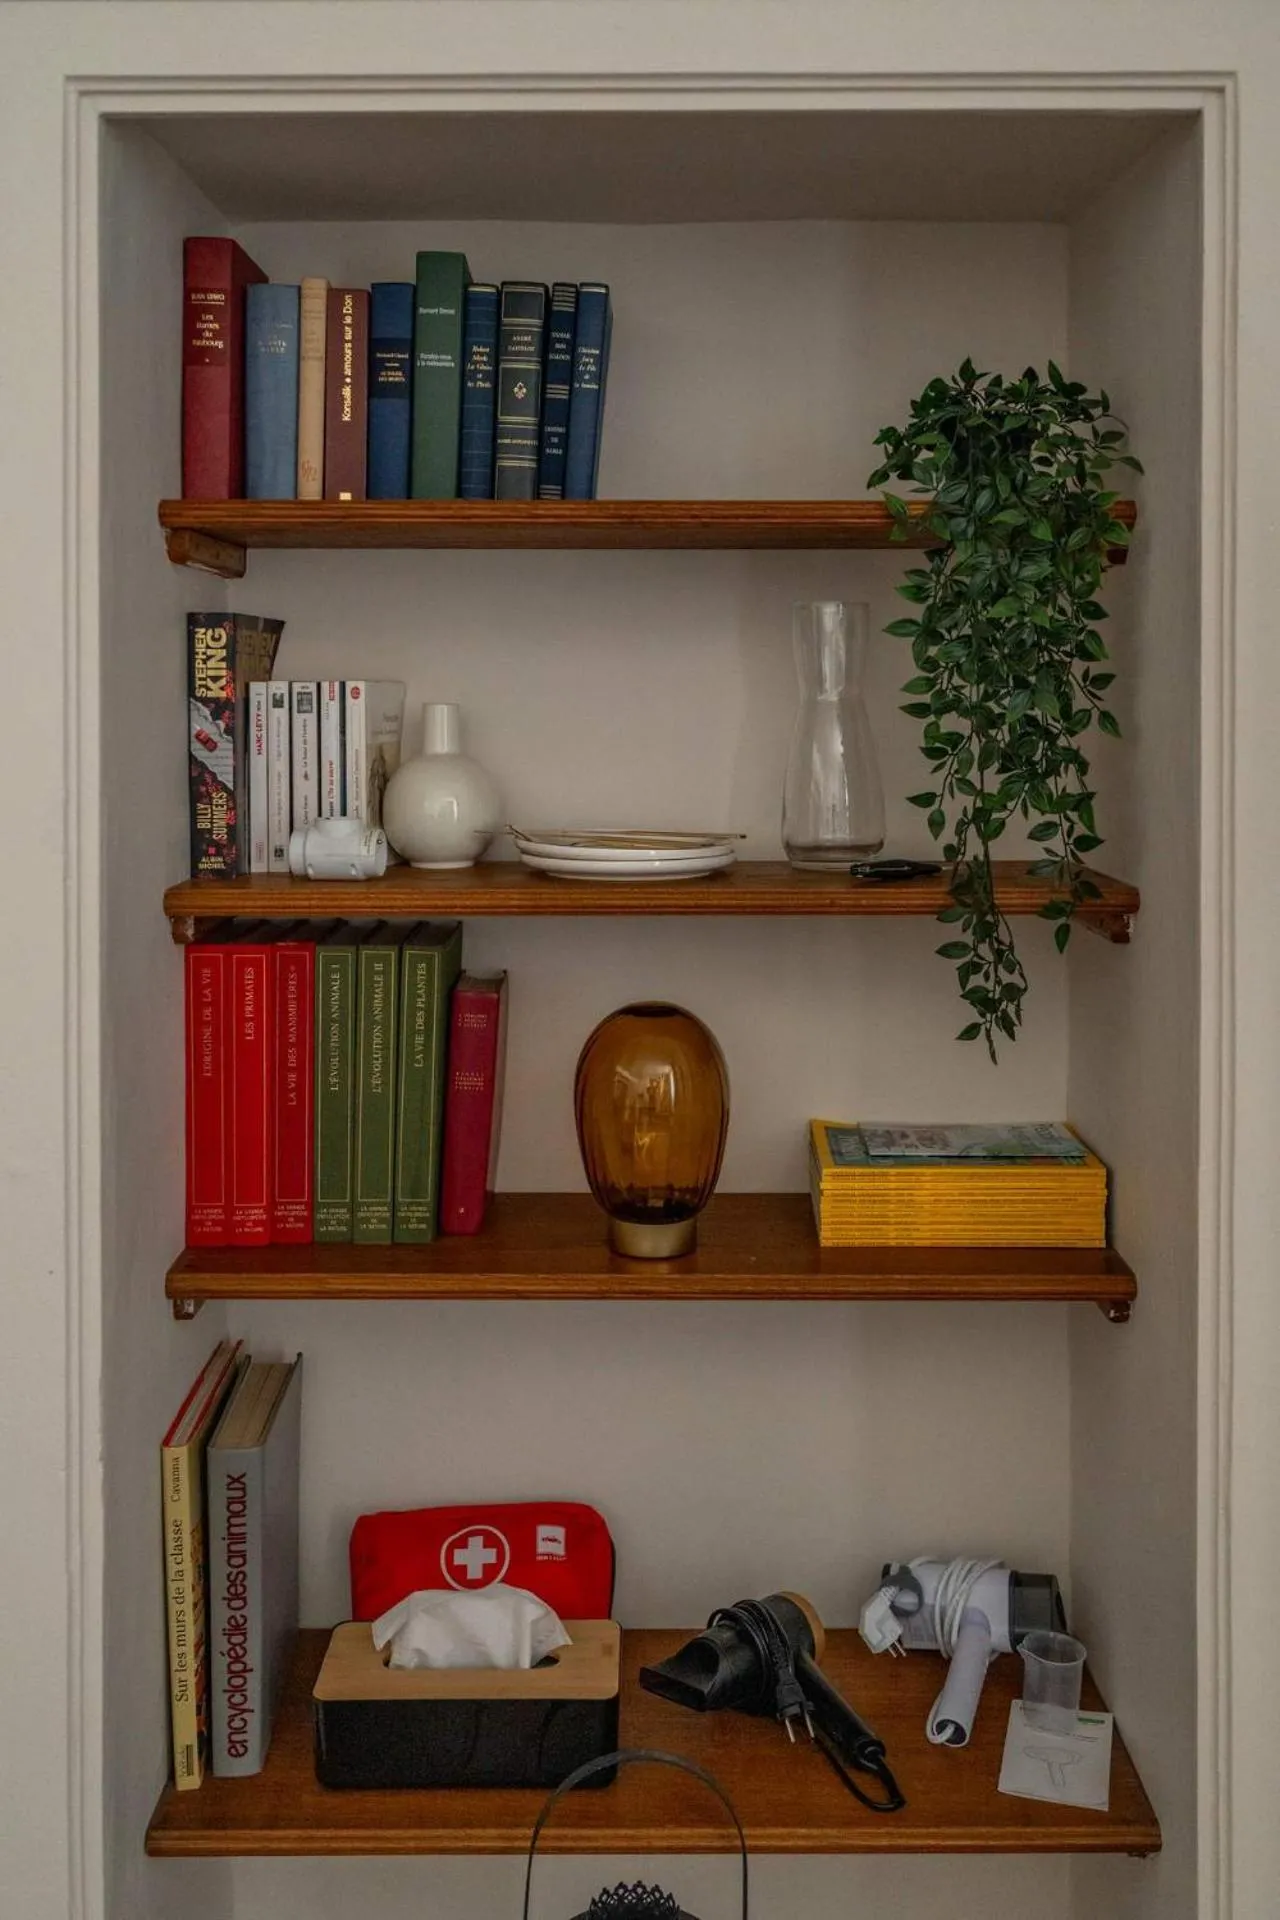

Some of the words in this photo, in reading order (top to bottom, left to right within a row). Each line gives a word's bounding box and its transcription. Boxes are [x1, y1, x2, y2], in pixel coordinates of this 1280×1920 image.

[342, 295, 353, 314] Don
[342, 315, 352, 324] le
[343, 326, 352, 340] sur
[343, 342, 352, 376] amours
[195, 627, 207, 698] STEPHEN
[207, 626, 228, 699] KING
[256, 713, 264, 732] LEVY
[256, 733, 264, 756] MARC
[197, 802, 211, 829] BILLY
[212, 791, 228, 840] SUMMERS
[201, 967, 211, 984] VIE
[374, 962, 385, 971] II
[202, 988, 212, 1002] LA
[244, 967, 256, 1018] PRIMATES
[330, 971, 341, 1019] ANIMALE
[416, 963, 427, 1008] PLANTES
[373, 974, 385, 1023] ANIMALE
[202, 1006, 212, 1021] DE
[415, 1010, 426, 1030] DES
[245, 1020, 256, 1040] LES
[415, 1033, 426, 1052] VIE
[288, 1047, 297, 1067] DES
[414, 1054, 425, 1068] LA
[288, 1072, 297, 1088] VIE
[288, 1092, 297, 1106] LA
[170, 1456, 181, 1502] Cavanna
[221, 1471, 248, 1570] animaux
[169, 1519, 184, 1565] classe
[170, 1568, 185, 1582] la
[171, 1586, 186, 1605] de
[222, 1570, 247, 1611] des
[176, 1609, 188, 1647] murs
[173, 1651, 188, 1673] les
[174, 1679, 190, 1703] Sur
[220, 1613, 254, 1758] encyclopédie
